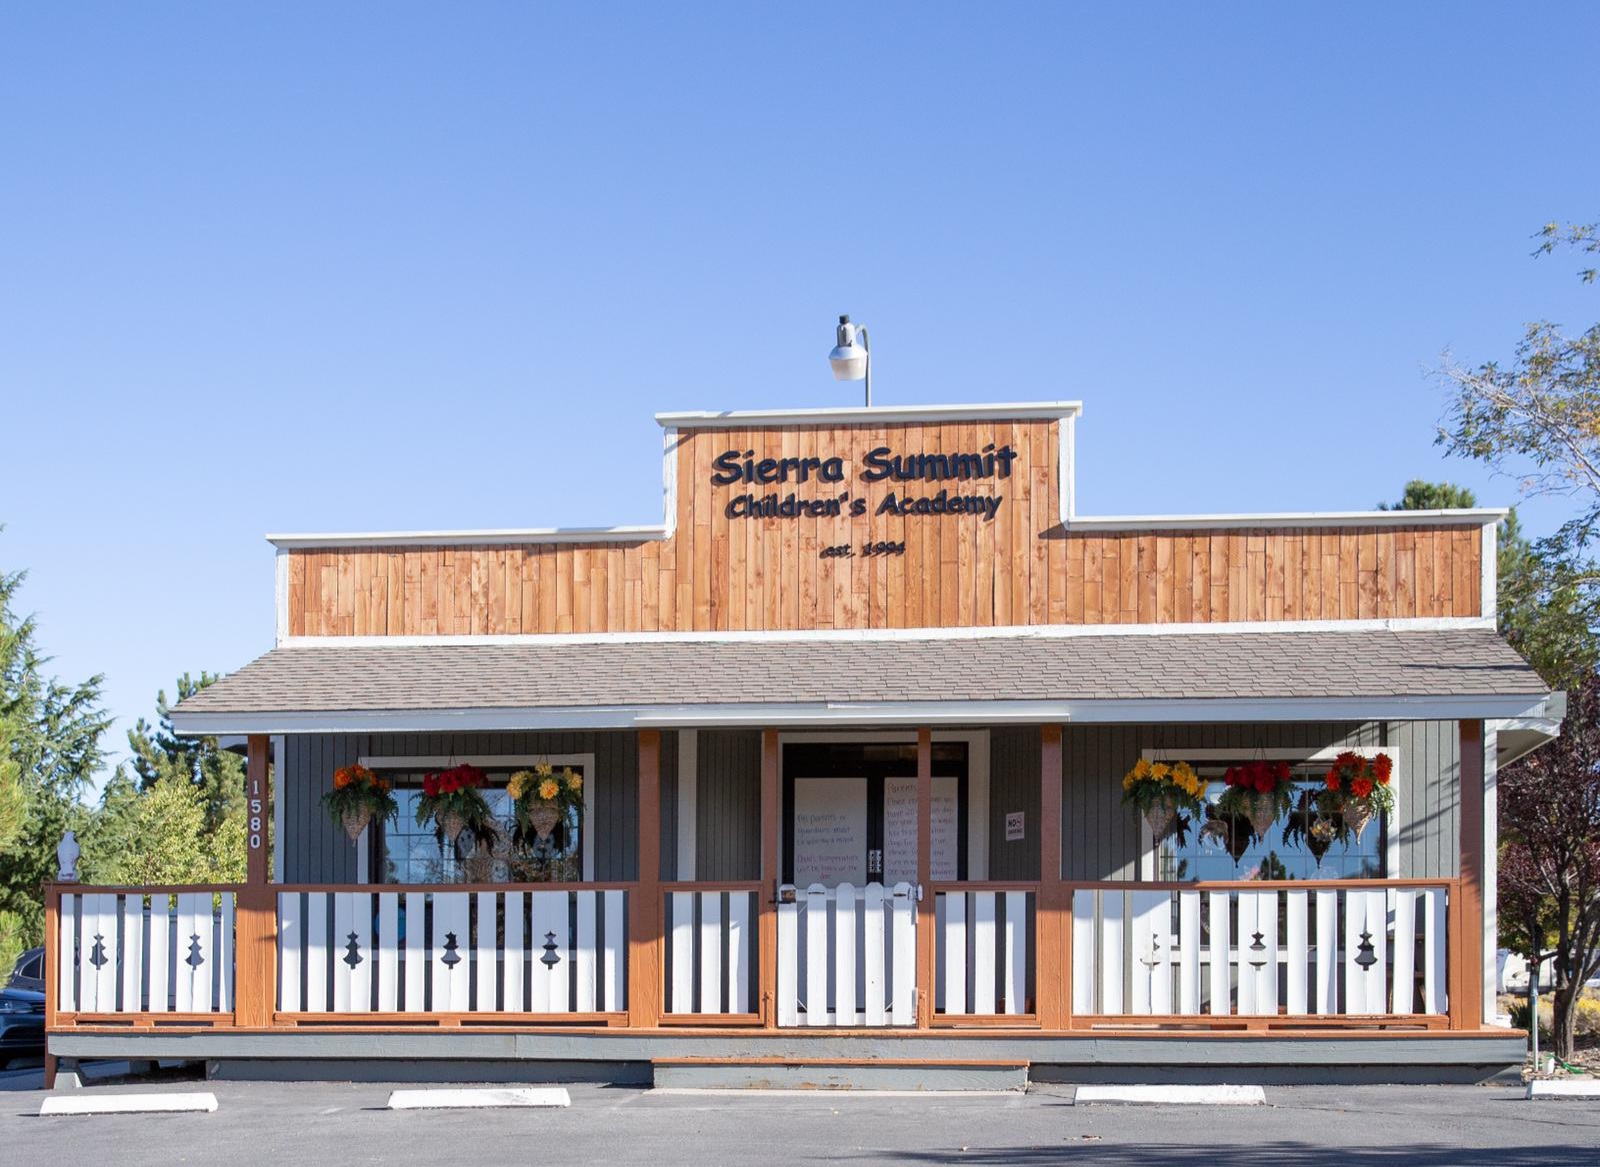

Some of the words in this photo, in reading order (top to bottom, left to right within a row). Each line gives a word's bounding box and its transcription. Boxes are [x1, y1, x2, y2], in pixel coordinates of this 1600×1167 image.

[712, 449, 845, 484] Sierra
[861, 443, 1017, 480] Summit
[726, 491, 867, 519] Children's
[876, 489, 1003, 521] Academy
[861, 540, 906, 557] 1994
[250, 780, 262, 849] 1580
